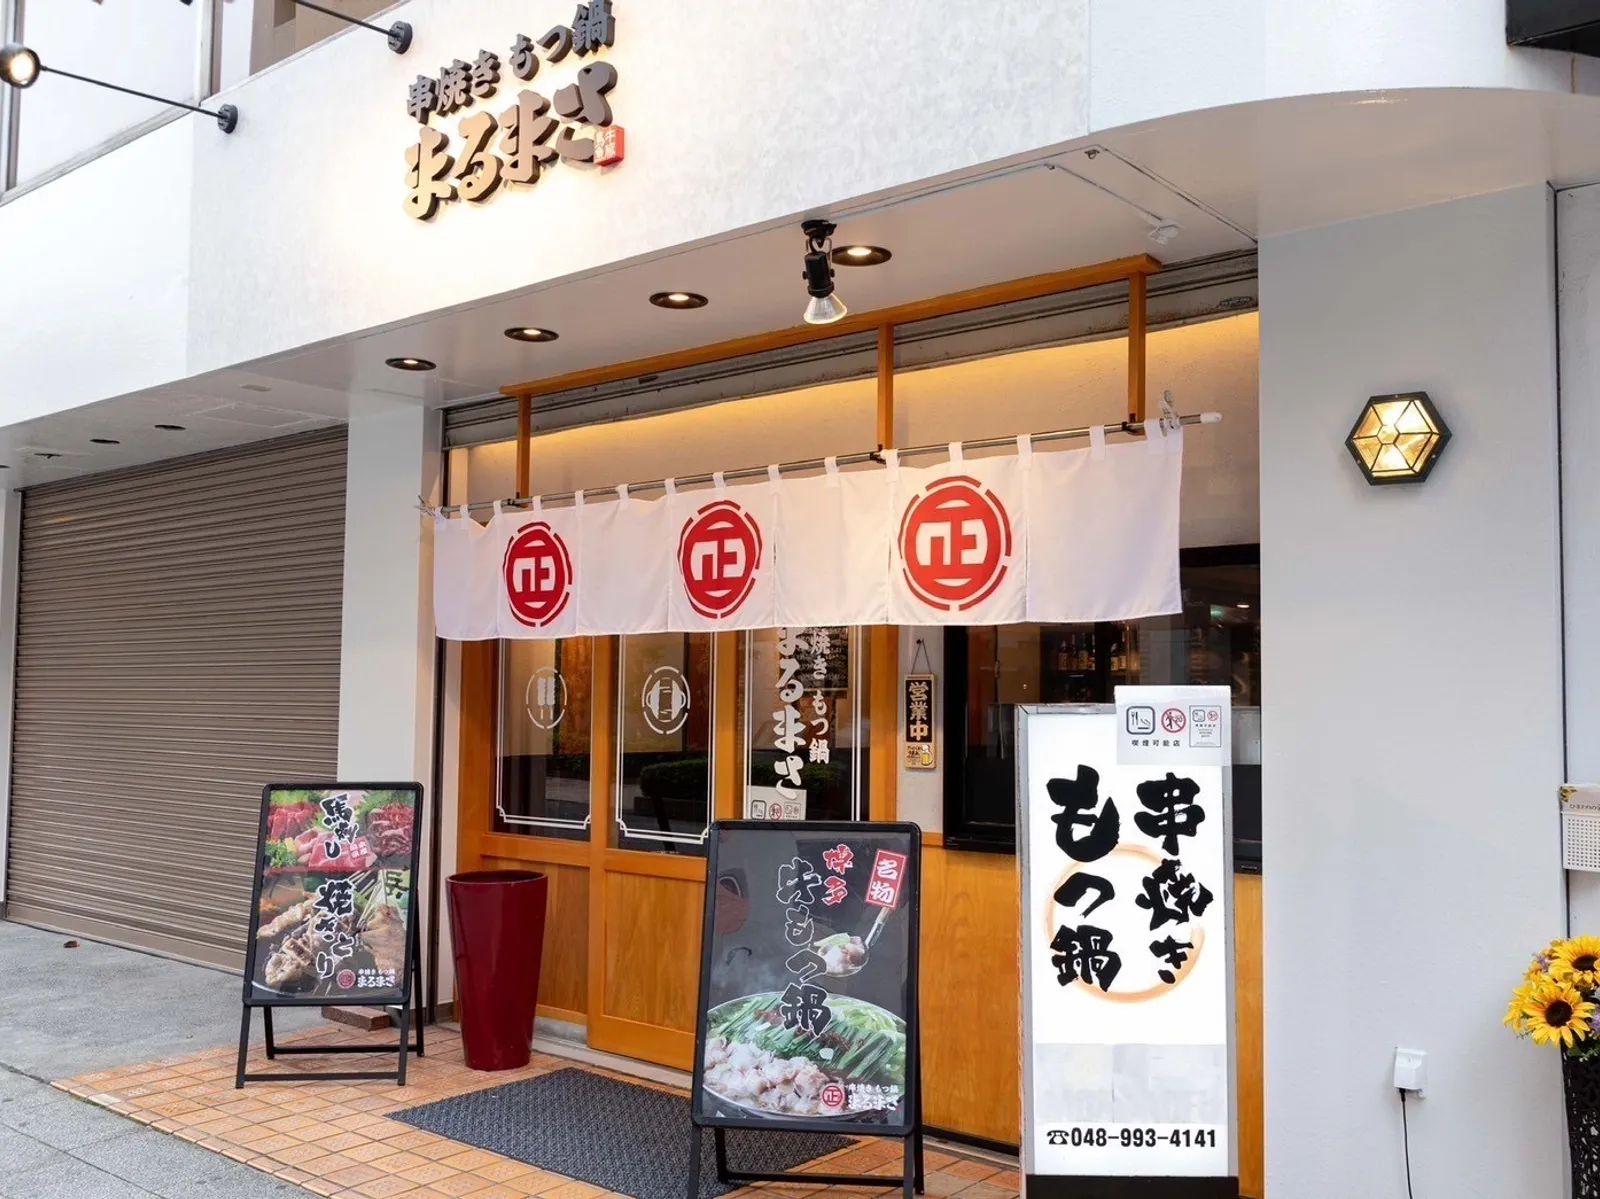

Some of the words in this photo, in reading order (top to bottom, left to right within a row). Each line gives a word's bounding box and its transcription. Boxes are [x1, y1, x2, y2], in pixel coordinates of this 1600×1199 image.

[405, 49, 502, 126] 串焼き
[509, 0, 617, 81] もつ鍋
[403, 61, 619, 221] まるまさ
[809, 690, 830, 764] もつ鍋
[909, 682, 929, 741] 営業中
[822, 844, 854, 906] 博多
[870, 859, 899, 904] 名物
[1046, 764, 1122, 992] もつ鍋
[1134, 772, 1214, 984] 串焼き
[357, 975, 396, 988] まるまさ
[848, 1092, 900, 1111] まるまさ
[1071, 1127, 1216, 1148] 048-993-4141
